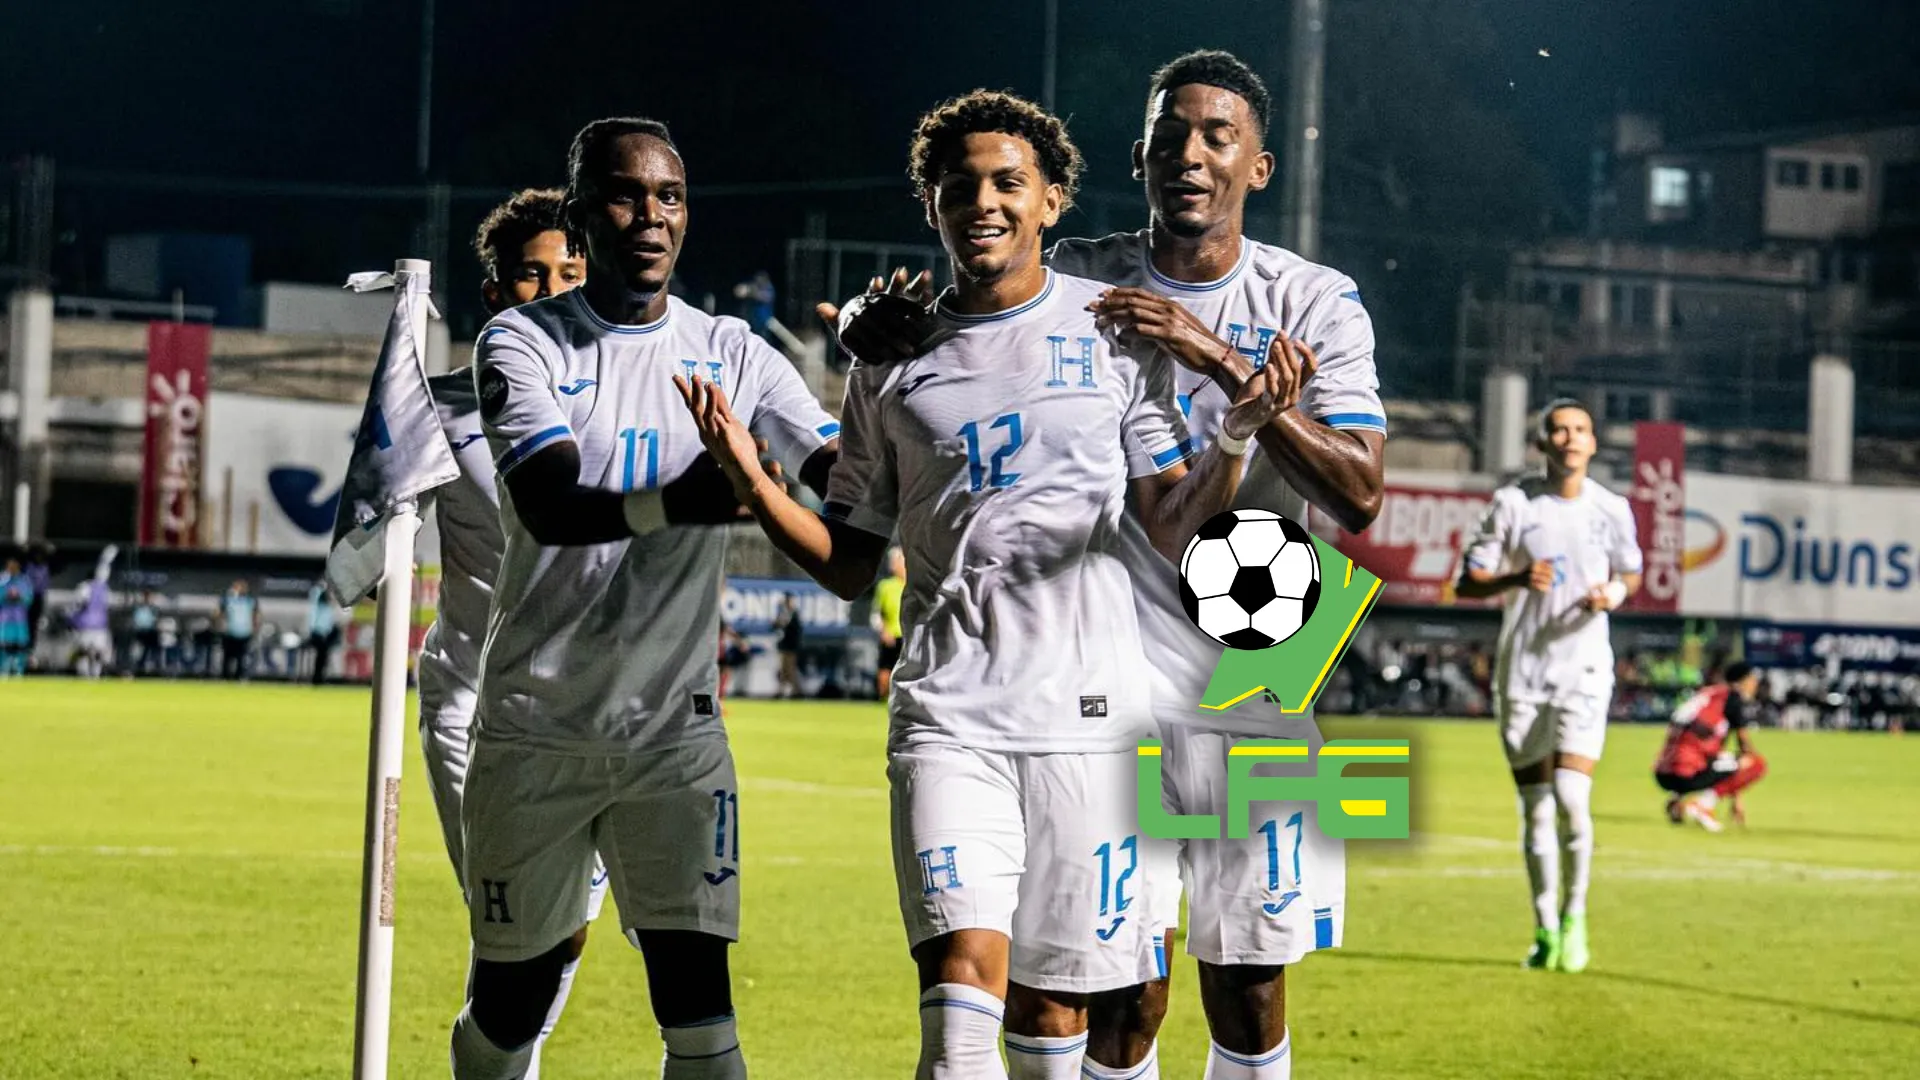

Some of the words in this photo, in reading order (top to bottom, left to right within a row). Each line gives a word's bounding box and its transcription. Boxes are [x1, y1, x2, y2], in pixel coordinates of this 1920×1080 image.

[1045, 335, 1098, 388] H
[1228, 323, 1277, 369] H
[619, 428, 658, 493] 11
[955, 412, 1022, 491] 12
[1740, 512, 1920, 589] Diuns
[712, 789, 738, 862] 11
[481, 878, 514, 924] H
[917, 845, 963, 894] H
[1092, 834, 1138, 916] 12
